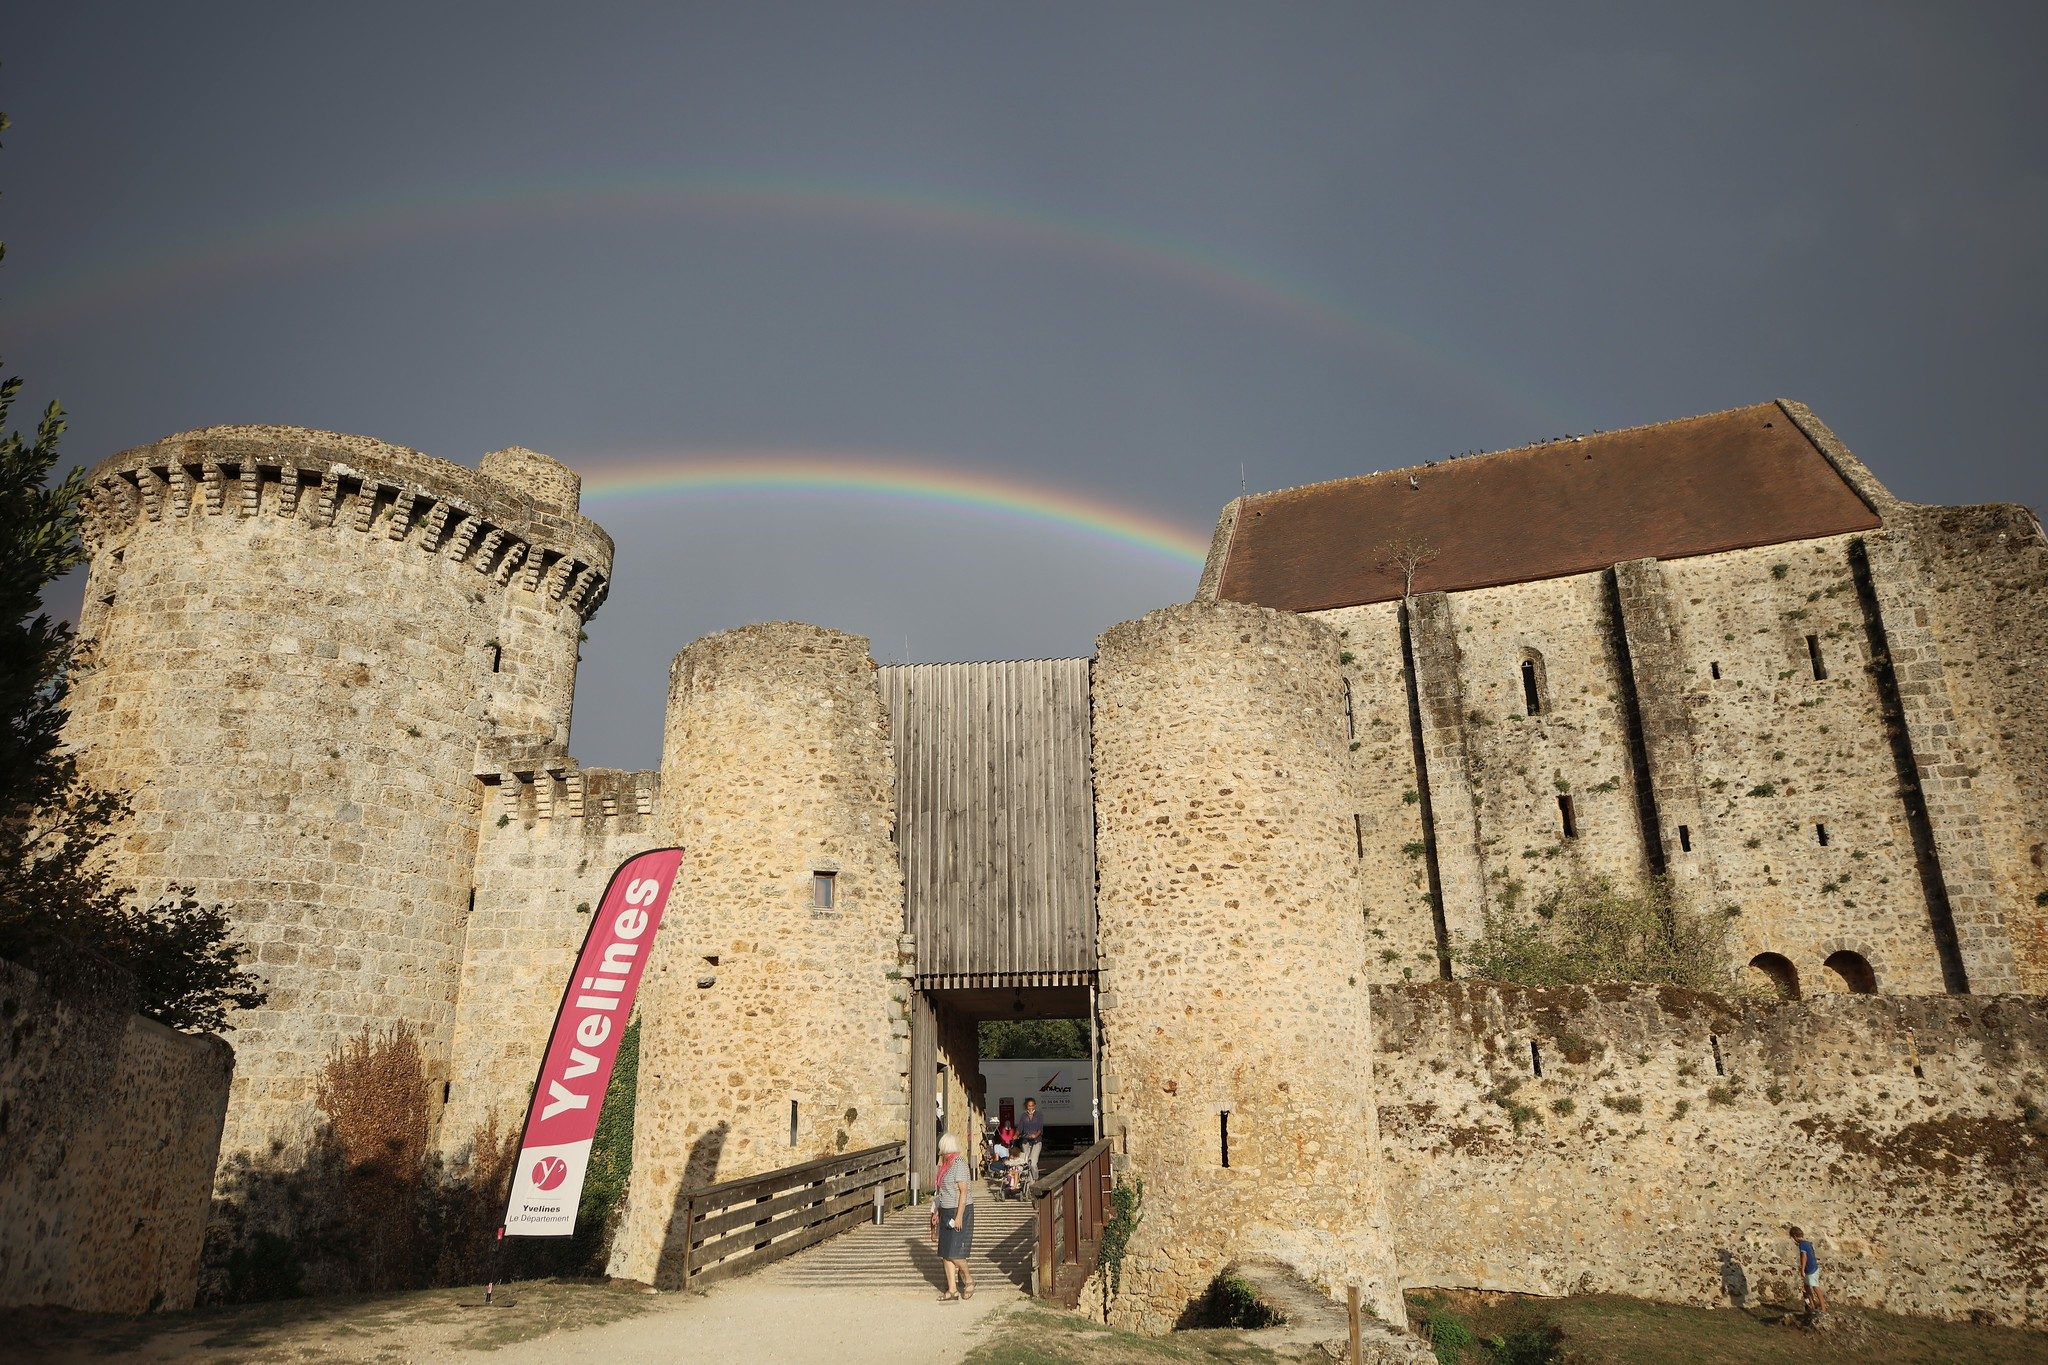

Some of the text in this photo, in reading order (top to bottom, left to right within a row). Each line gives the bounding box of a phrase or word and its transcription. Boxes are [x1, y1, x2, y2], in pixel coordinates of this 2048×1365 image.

[541, 877, 660, 1122] Yvelines
[523, 1204, 561, 1213] Yvelines
[509, 1214, 570, 1224] Le Département
